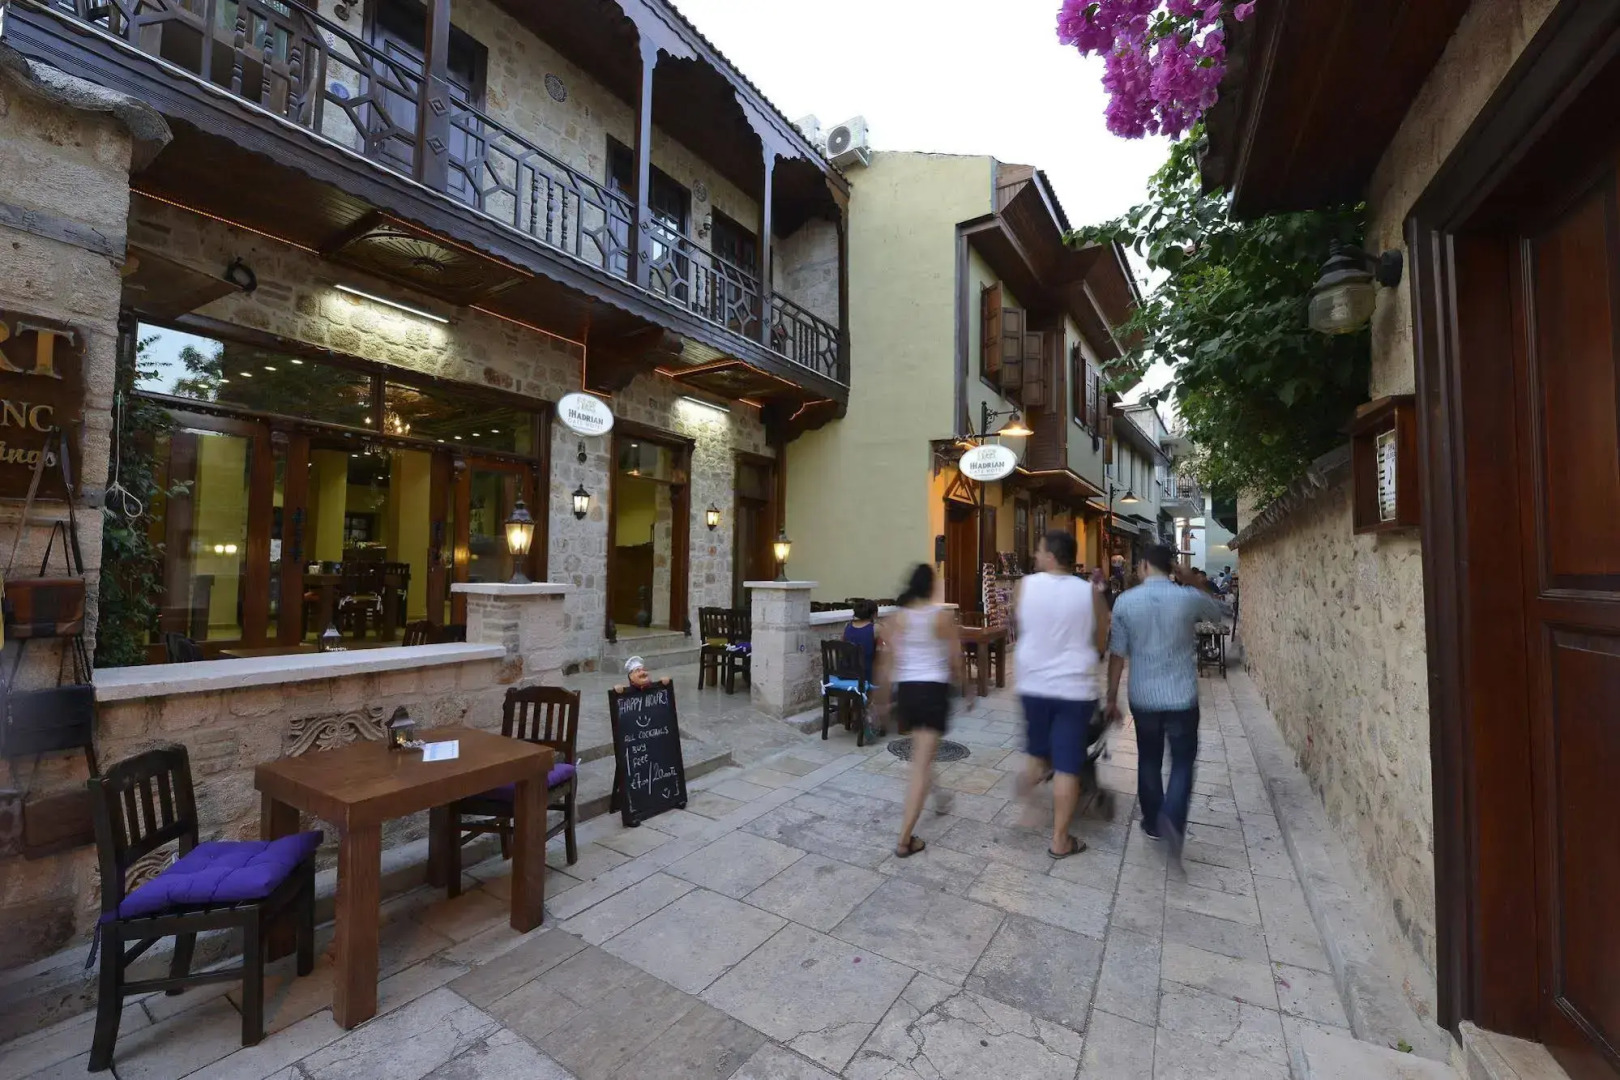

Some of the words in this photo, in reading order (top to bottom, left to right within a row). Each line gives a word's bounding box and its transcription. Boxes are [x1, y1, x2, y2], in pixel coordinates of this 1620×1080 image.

[618, 697, 643, 714] HAPPY
[624, 734, 636, 742] ALL
[638, 726, 670, 739] COCKTAILS
[632, 743, 647, 754] BUY
